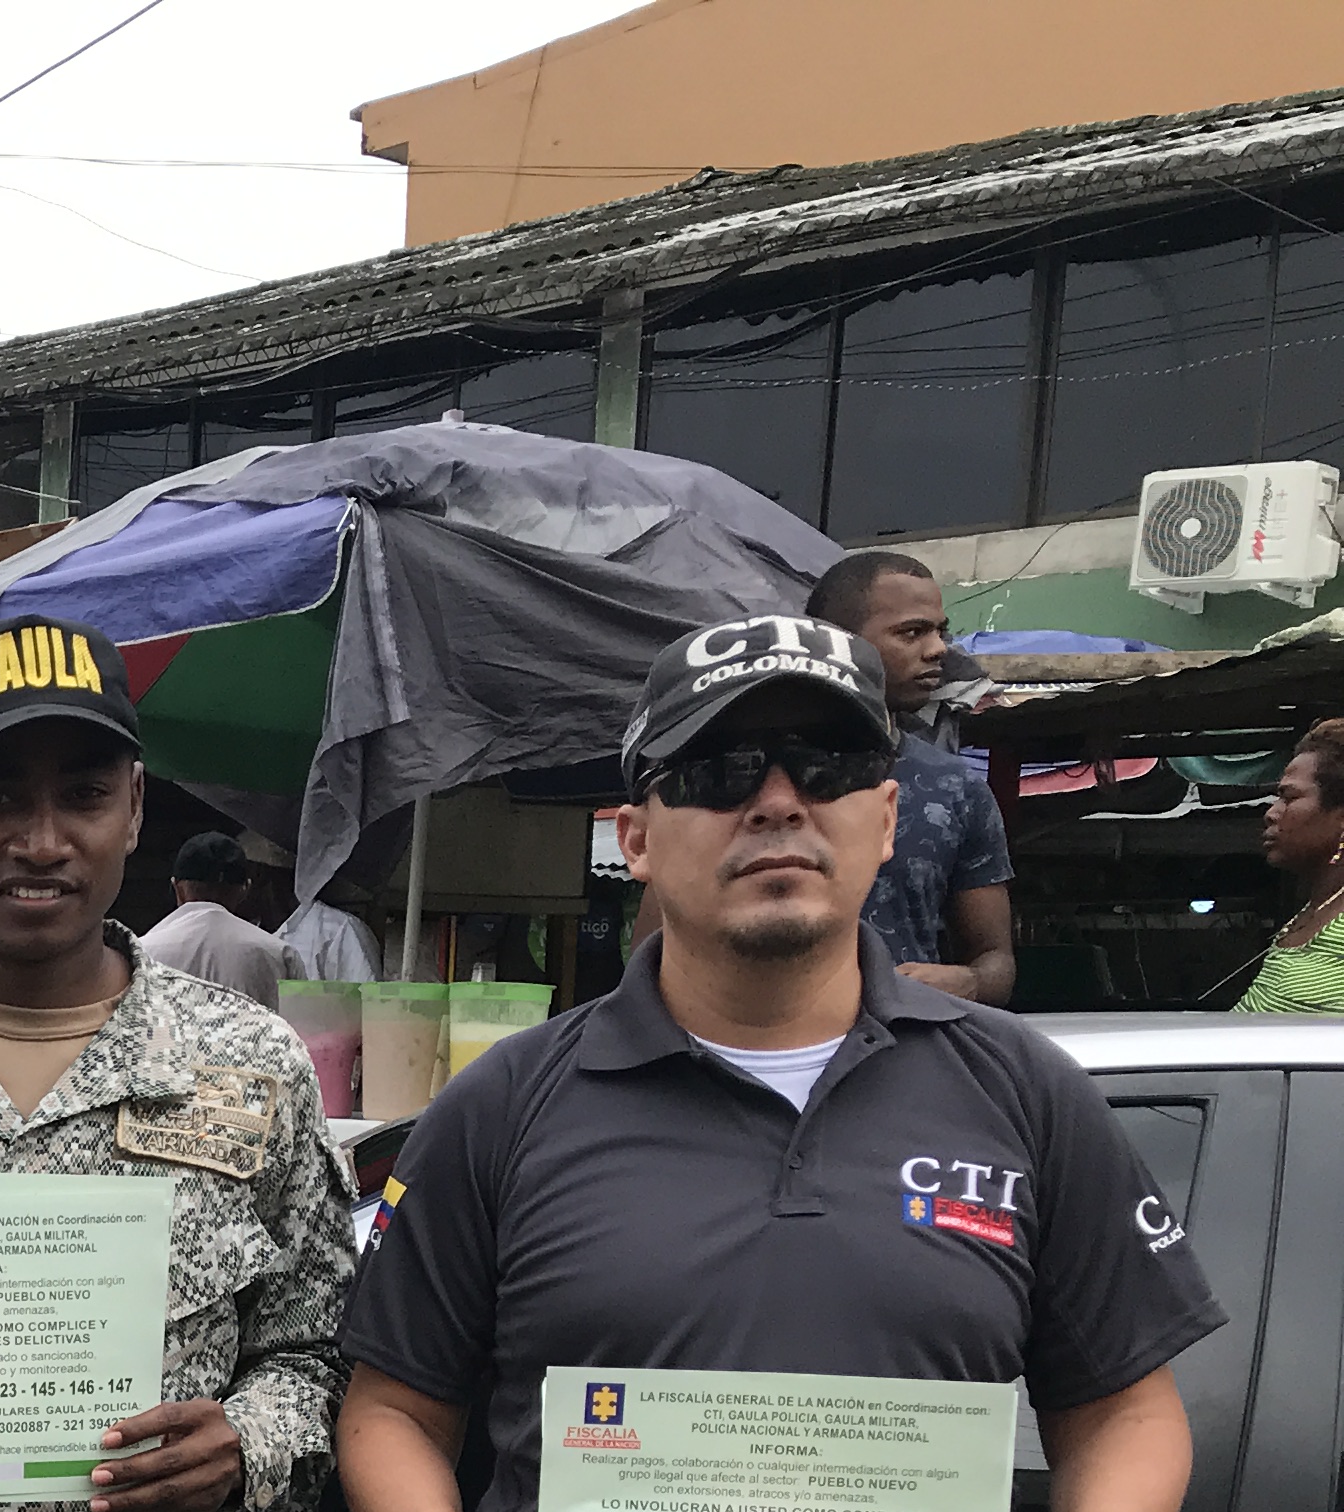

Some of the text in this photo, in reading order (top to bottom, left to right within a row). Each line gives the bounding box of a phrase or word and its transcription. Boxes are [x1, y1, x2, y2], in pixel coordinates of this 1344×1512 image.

[686, 615, 859, 671] CTI
[692, 655, 860, 693] COLOMBIA
[145, 1133, 242, 1166] ARMADA
[901, 1157, 1024, 1211] CTI
[48, 1290, 90, 1301] NUEVO
[27, 1320, 96, 1332] COMPLICE
[99, 1320, 108, 1330] Y
[14, 1334, 90, 1346] DELICTIVAS
[29, 1381, 56, 1397] 145
[69, 1380, 95, 1396] 146
[108, 1380, 134, 1395] 147
[567, 1426, 639, 1439] FISCALIA
[749, 1444, 824, 1457] INFORMA:
[808, 1476, 918, 1492] PUEBLO NUEVO
[601, 1499, 621, 1510] LO
